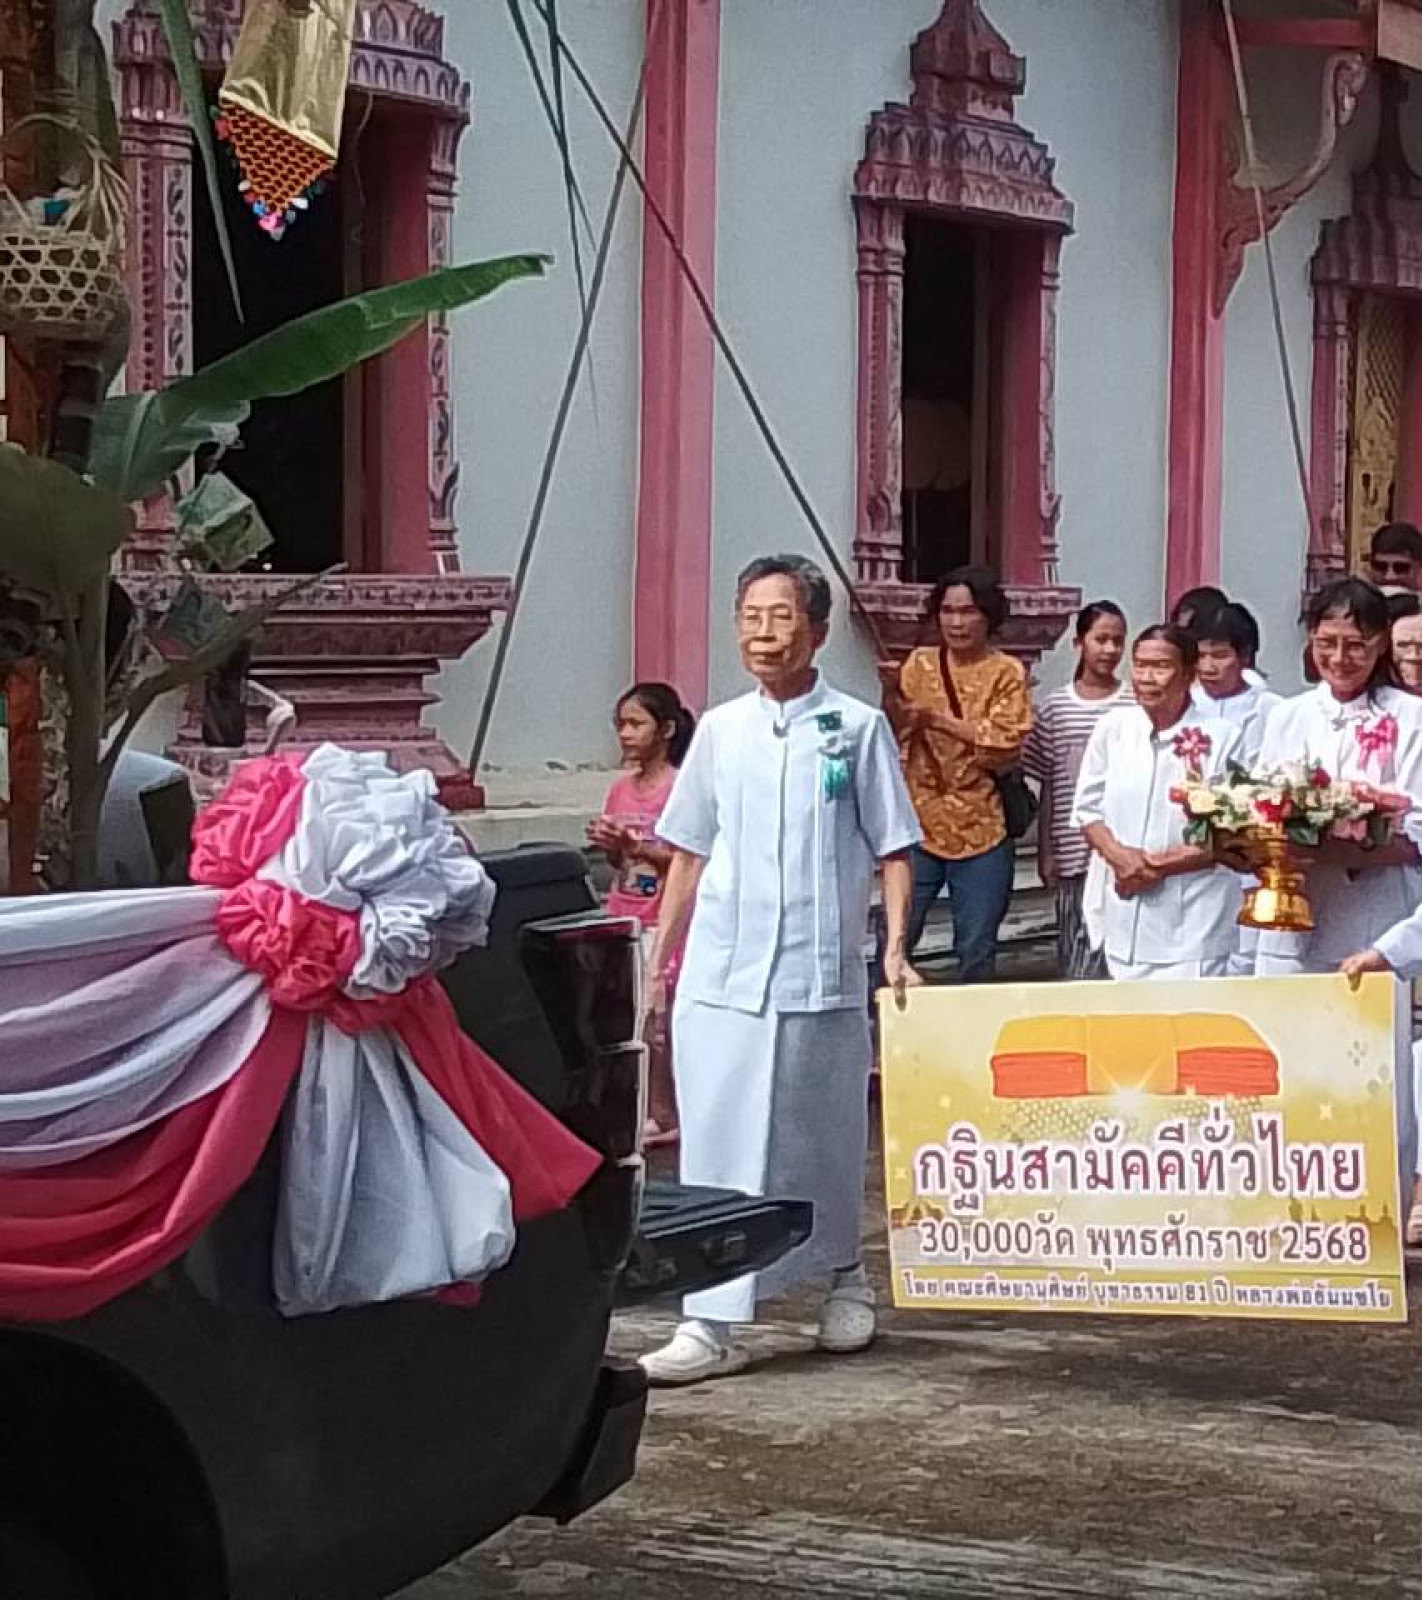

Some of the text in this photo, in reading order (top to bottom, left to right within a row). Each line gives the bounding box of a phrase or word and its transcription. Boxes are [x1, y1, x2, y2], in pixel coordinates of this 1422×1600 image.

[918, 1106, 1361, 1210] กฐินสามัคคีทั่วไทย
[921, 1212, 1368, 1270] 30,000วัด พุทธศักราช 2568
[903, 1271, 937, 1296] โดย
[1185, 1284, 1206, 1301] 81
[1213, 1278, 1228, 1301] ปี
